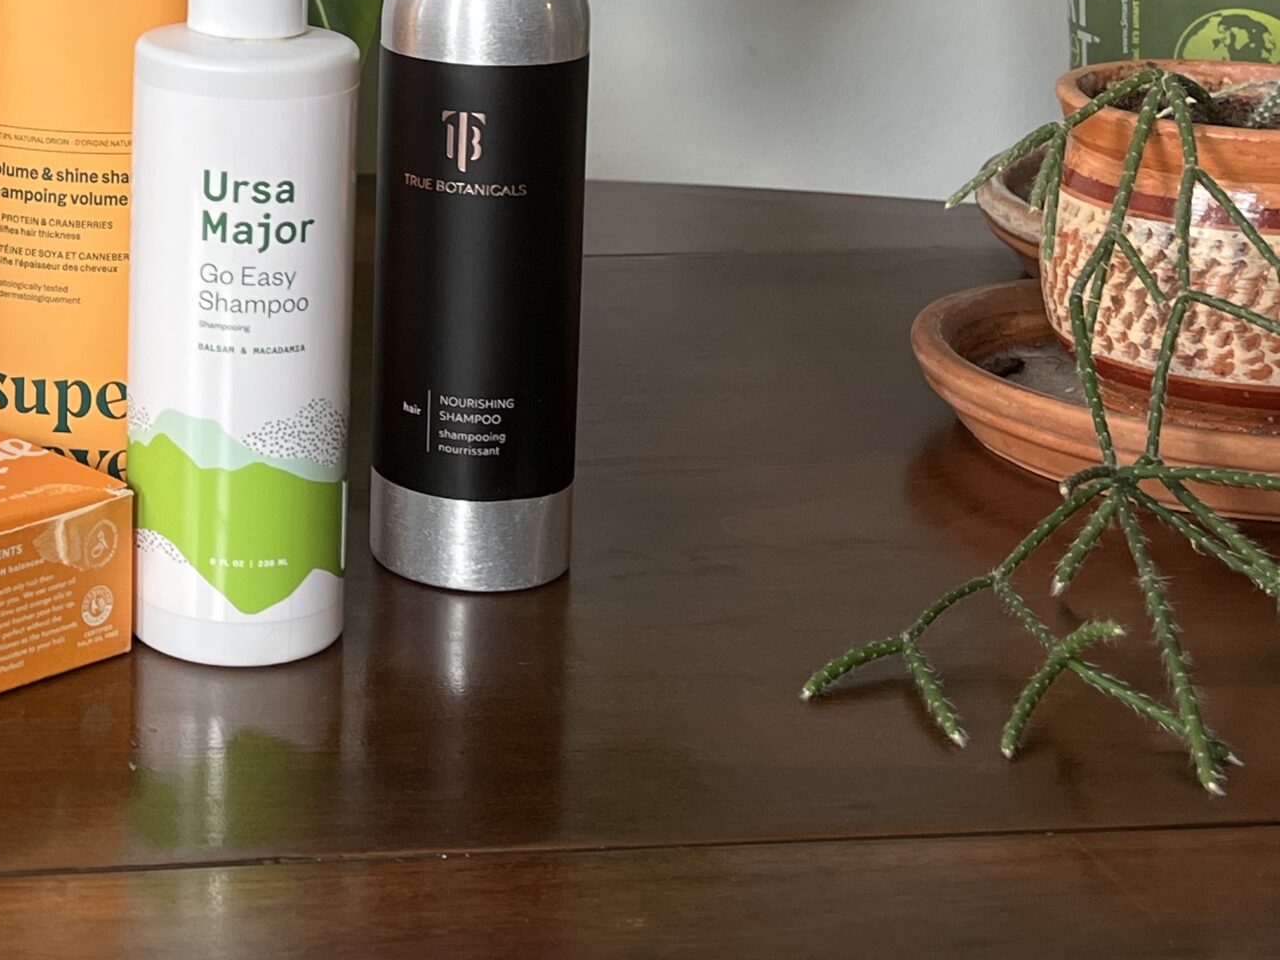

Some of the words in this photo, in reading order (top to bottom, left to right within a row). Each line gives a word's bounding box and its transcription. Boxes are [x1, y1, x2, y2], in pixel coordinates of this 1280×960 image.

[14, 134, 44, 144] NATURAL
[45, 137, 69, 145] ORIGIN
[42, 167, 53, 181] &
[56, 168, 99, 184] shine
[101, 170, 129, 184] sha
[203, 169, 295, 204] Ursa
[404, 172, 433, 190] TRUE
[436, 180, 528, 196] BOTANICALS
[70, 192, 129, 206] volume
[1, 213, 40, 226] PROTEIN
[48, 218, 113, 229] CRANBERRIES
[20, 228, 37, 237] hair
[38, 230, 81, 240] thickness
[202, 210, 315, 254] Major
[25, 248, 37, 257] DE
[38, 249, 64, 259] SOYA
[65, 251, 76, 260] ET
[79, 252, 130, 261] CANNEBER
[62, 263, 79, 272] des
[80, 264, 118, 273] cheveux
[200, 263, 234, 285] Go
[241, 266, 297, 290] Easy
[43, 284, 68, 294] tested
[199, 290, 309, 319] Shampoo
[198, 320, 251, 333] Shampooing
[240, 347, 247, 355] &
[253, 344, 306, 355] MACADAMIA
[403, 401, 422, 415] hair
[439, 395, 515, 409] NOURISHING
[439, 410, 502, 425] SHAMPOO
[438, 429, 506, 444] shampooing
[438, 443, 500, 456] nourrissant
